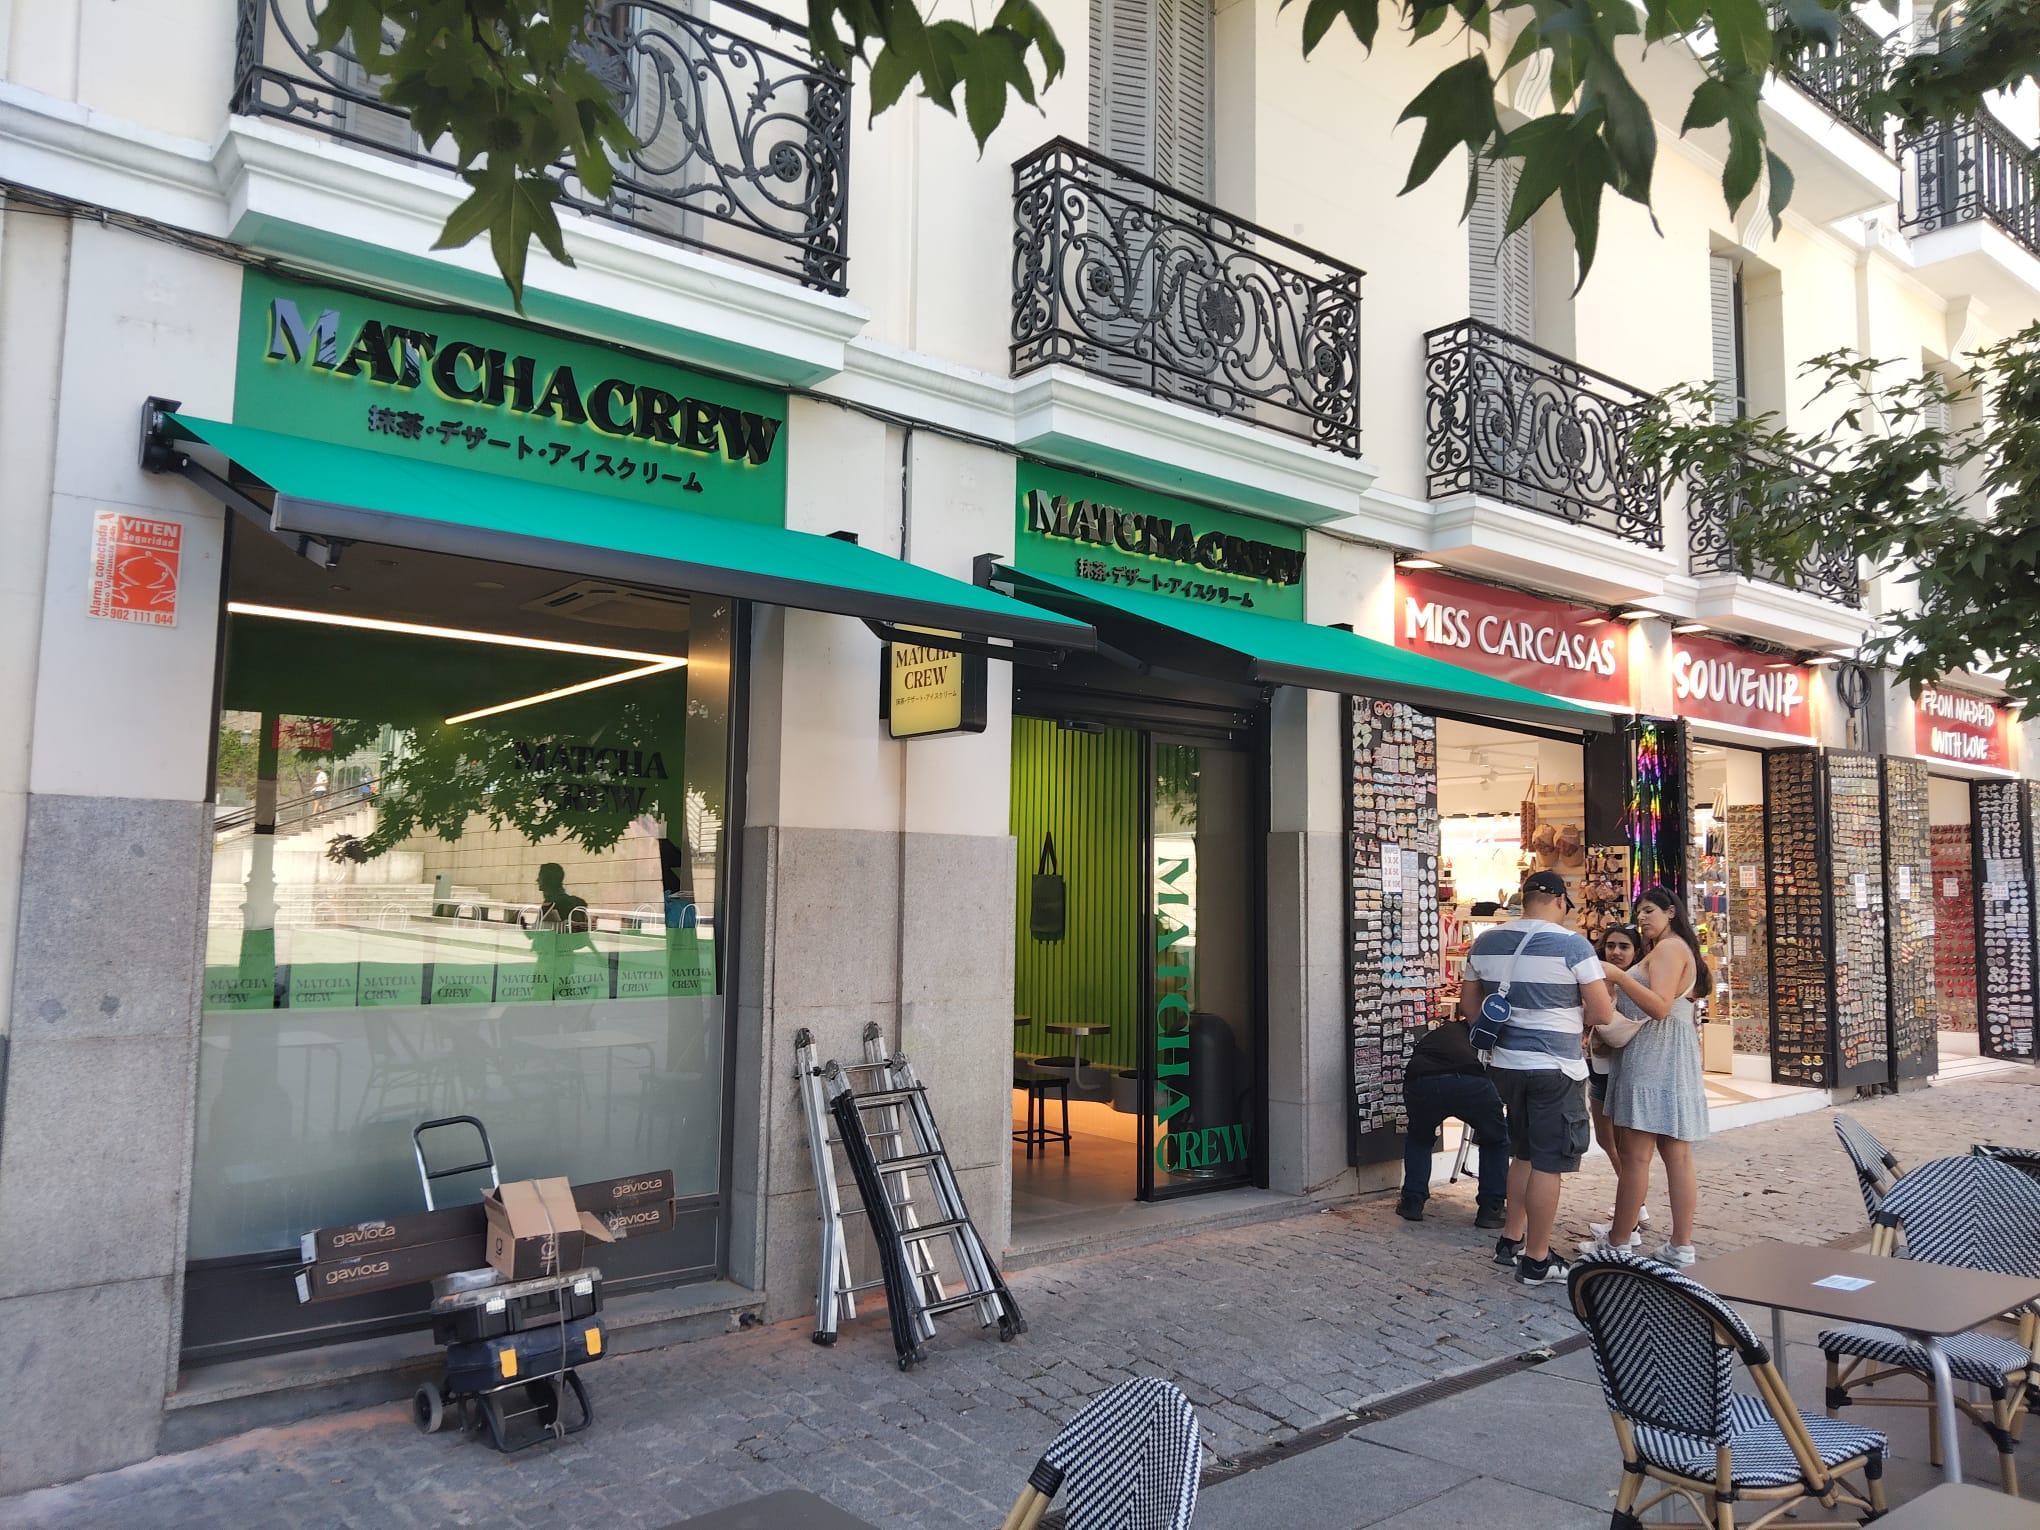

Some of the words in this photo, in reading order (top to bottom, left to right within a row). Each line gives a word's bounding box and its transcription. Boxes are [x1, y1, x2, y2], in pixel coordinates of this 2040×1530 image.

[122, 518, 177, 538] VITEN
[123, 532, 174, 547] Seguridad
[95, 524, 109, 578] conectada
[90, 580, 104, 617] Alarma
[110, 608, 129, 620] 902
[134, 611, 151, 622] 111
[154, 613, 173, 625] 044
[1405, 597, 1470, 648] MISS
[1477, 615, 1617, 676] CARCASAS
[905, 666, 947, 689] CREW
[1673, 651, 1804, 717] SOUVENIR
[1921, 690, 1954, 719] FROM
[1955, 698, 1995, 728] MADRID
[1931, 727, 1962, 757] WITH
[1963, 732, 1988, 760] LOVE
[364, 976, 416, 987] MATCHA
[438, 975, 487, 985] MATCHA
[502, 974, 549, 984] MATCHA
[558, 973, 604, 986] MATCHA
[621, 970, 664, 980] MATCHA
[672, 967, 712, 977] MATCHA
[210, 977, 268, 990] MATCHA
[296, 978, 351, 990] MATCHA
[1157, 857, 1191, 1125] MATCHA
[1156, 1123, 1250, 1173] CREW
[612, 1178, 663, 1198] gaviota
[608, 1210, 660, 1230] gaviota
[332, 1225, 396, 1248] gaviota
[326, 1261, 390, 1285] gaviota
